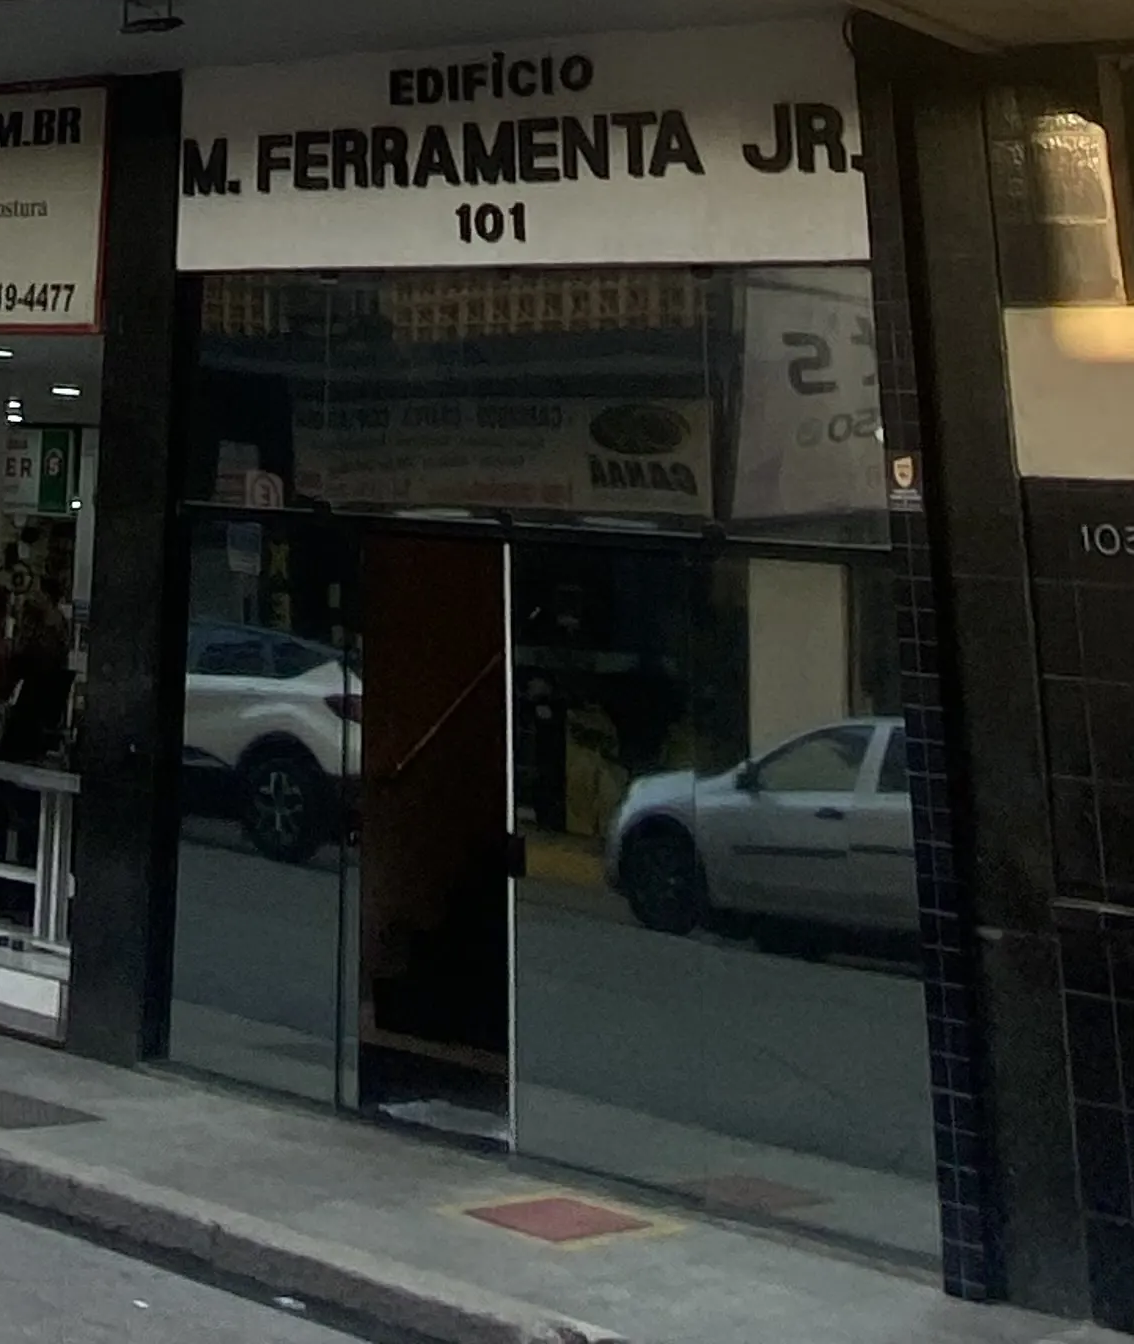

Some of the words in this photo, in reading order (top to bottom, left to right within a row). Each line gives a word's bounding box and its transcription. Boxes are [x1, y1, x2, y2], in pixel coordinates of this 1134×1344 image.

[389, 52, 595, 106] EDIFÍCIO
[181, 137, 241, 196] M.
[256, 109, 706, 194] FERRAMENTA
[742, 102, 868, 175] JR.
[455, 203, 527, 244] 101
